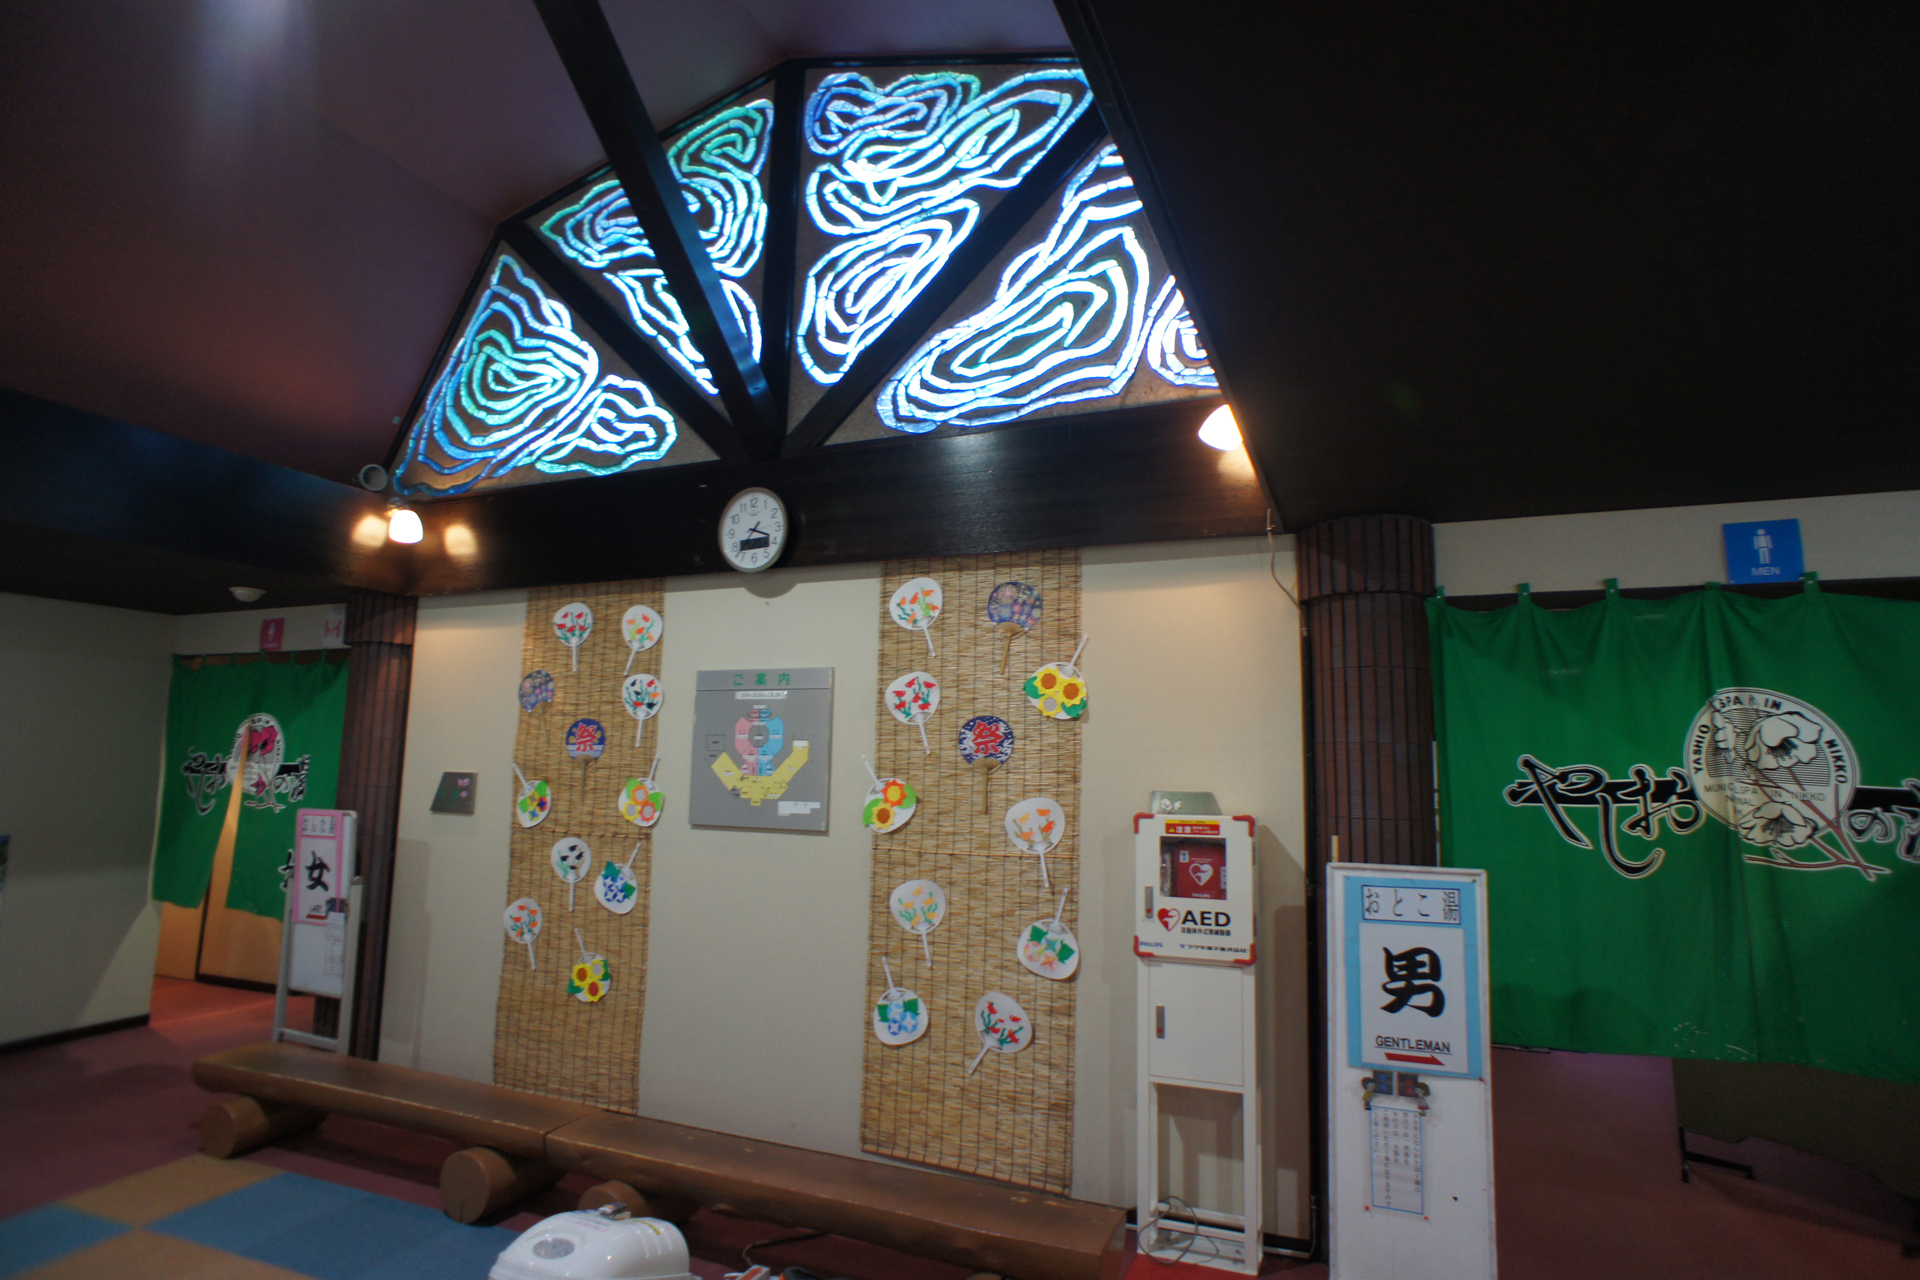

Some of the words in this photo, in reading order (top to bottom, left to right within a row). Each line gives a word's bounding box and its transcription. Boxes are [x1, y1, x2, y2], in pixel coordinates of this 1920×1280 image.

[740, 503, 747, 513] 11
[750, 497, 758, 508] 12
[763, 500, 767, 509] 1
[771, 507, 778, 519] 2
[731, 514, 740, 525] 10
[774, 521, 781, 532] 3
[728, 528, 735, 539] 9
[732, 541, 738, 552] 8
[771, 536, 777, 546] 4
[740, 551, 746, 563] 7
[751, 552, 758, 563] 6
[763, 548, 769, 559] 5
[1751, 566, 1781, 576] MEN
[733, 673, 791, 686] ご案内
[574, 722, 599, 753] 祭
[970, 719, 1005, 756] 祭
[1692, 724, 1710, 775] YASHIO
[1718, 696, 1744, 709] SPA
[1763, 698, 1782, 711] IN
[1824, 739, 1848, 784] NIKKO
[1791, 791, 1825, 801] NIKKO
[305, 850, 330, 892] 女
[1365, 888, 1459, 921] おとこ湯
[1181, 910, 1230, 927] AED
[1380, 946, 1445, 1018] 男
[1375, 1035, 1451, 1053] GENTLEMAN
